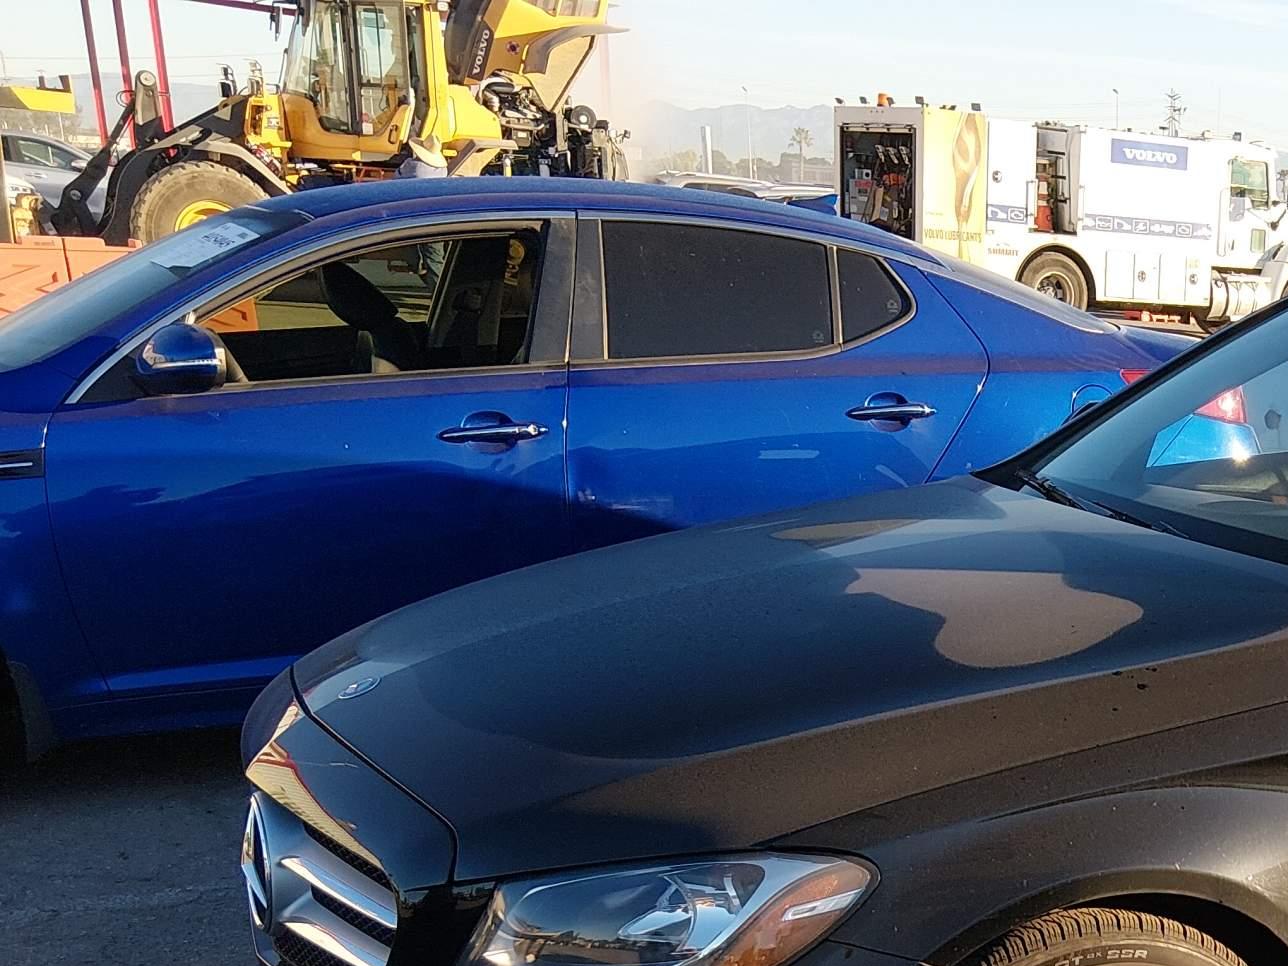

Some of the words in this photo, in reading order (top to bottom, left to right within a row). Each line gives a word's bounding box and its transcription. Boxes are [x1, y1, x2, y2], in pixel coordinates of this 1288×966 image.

[472, 29, 490, 76] VOLVO
[1122, 147, 1178, 164] VOLVO
[923, 228, 944, 240] VOLVO
[945, 230, 982, 243] LUBRICANTS
[1106, 949, 1148, 960] SSR
